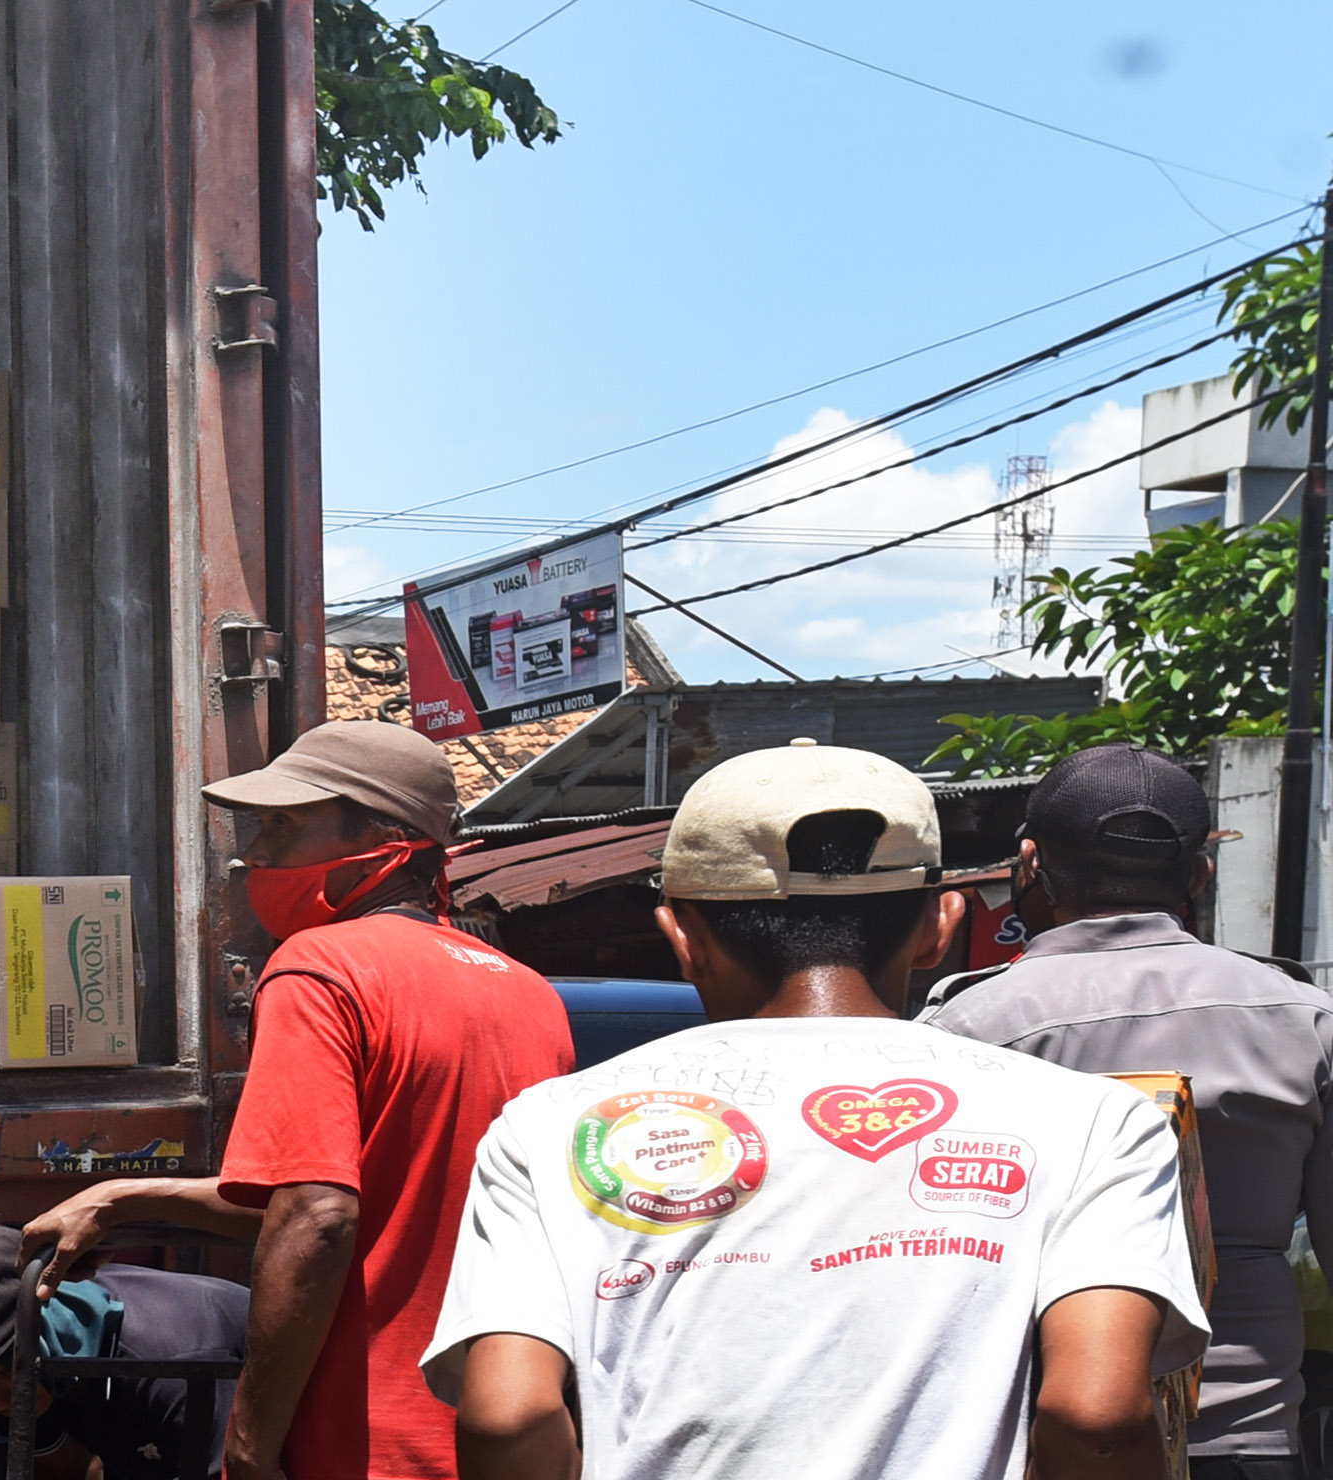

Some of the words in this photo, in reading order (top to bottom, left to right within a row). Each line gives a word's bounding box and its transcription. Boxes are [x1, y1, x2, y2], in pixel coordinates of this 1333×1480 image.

[493, 573, 528, 595] YUASA
[543, 556, 589, 582] BATTERY
[416, 699, 449, 716] Memang
[447, 710, 465, 726] Baik
[511, 707, 540, 723] HARUN
[541, 701, 562, 716] JAYA
[564, 693, 595, 710] MOTOR
[84, 918, 106, 1024] PROMOO
[616, 1094, 647, 1108] Zat
[653, 1093, 694, 1104] Besi
[837, 1096, 920, 1110] OMEGA
[839, 1109, 917, 1134] 3&6
[648, 1128, 690, 1141] Sasa
[635, 1138, 716, 1160] Platinum
[738, 1130, 764, 1162] Zink
[933, 1138, 1021, 1159] SUMBER
[120, 1159, 158, 1172] HATI
[932, 1161, 1014, 1188] SERAT
[633, 1196, 687, 1215] Vitamin
[689, 1199, 706, 1213] B2
[924, 1191, 965, 1202] SOURCE
[969, 1192, 982, 1202] OF
[984, 1194, 1011, 1209] FIBER
[868, 1230, 906, 1243] MOVE
[909, 1229, 927, 1238] ON
[931, 1227, 948, 1237] KE
[660, 1256, 710, 1274] EPUN
[715, 1252, 771, 1265] BUMBU
[810, 1241, 892, 1272] SANTAN
[900, 1236, 1004, 1264] TERINDAH
